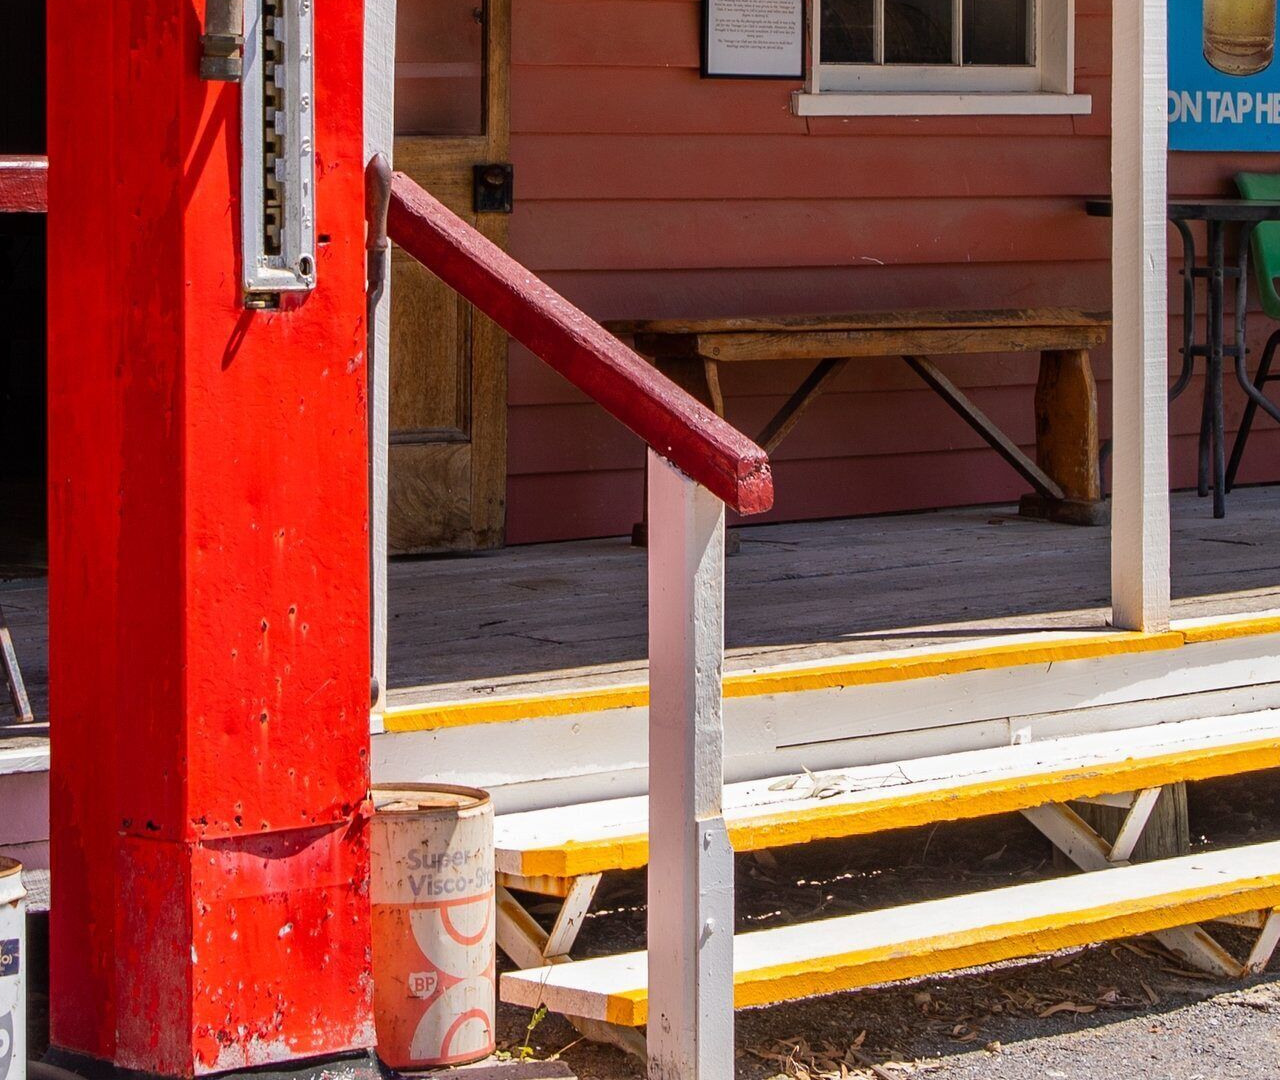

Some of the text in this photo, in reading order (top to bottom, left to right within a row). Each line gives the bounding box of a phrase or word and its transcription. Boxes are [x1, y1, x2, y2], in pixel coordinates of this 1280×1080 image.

[1167, 90, 1202, 123] ON
[1206, 91, 1253, 124] TAP
[407, 848, 470, 874] Super
[414, 976, 436, 993] BP
